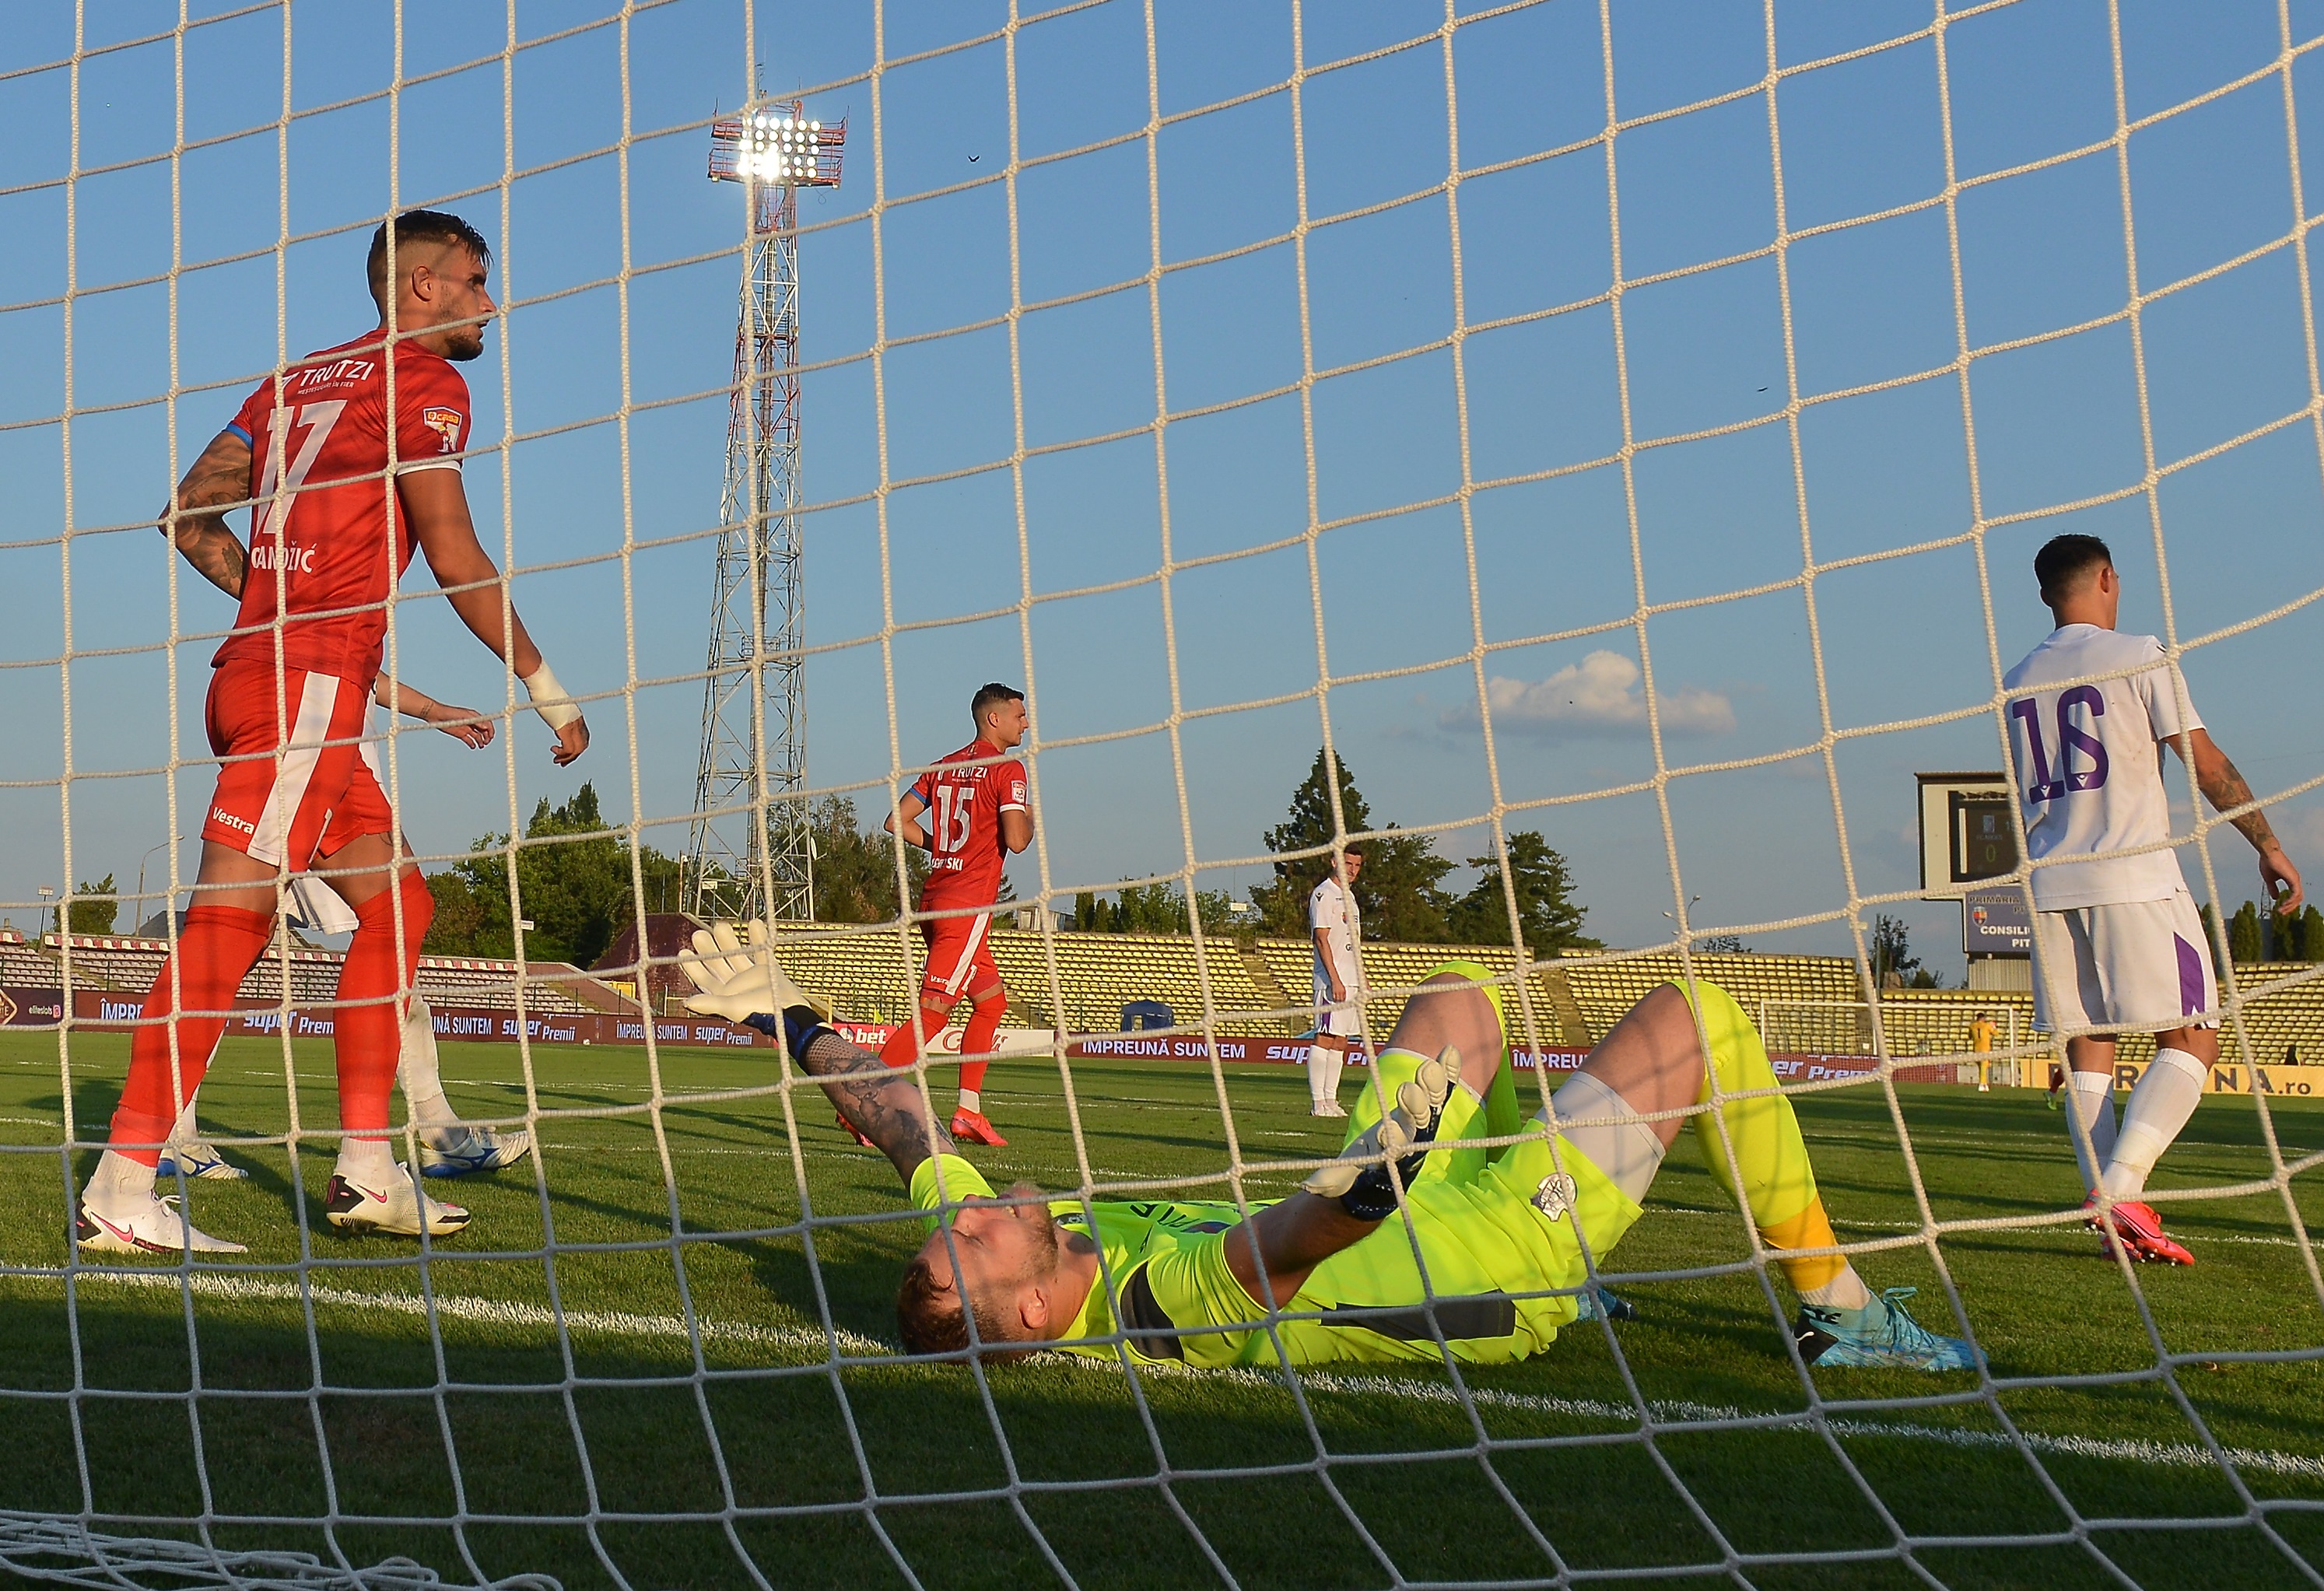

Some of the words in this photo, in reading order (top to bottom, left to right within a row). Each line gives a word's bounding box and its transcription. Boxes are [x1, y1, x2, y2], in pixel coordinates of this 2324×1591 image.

[300, 359, 375, 387] TRUTZI
[254, 399, 348, 540] 17
[2012, 685, 2109, 804] 16
[212, 807, 255, 835] Vestra
[937, 785, 975, 853] 15
[1980, 925, 2030, 935] CONSILI
[243, 1008, 297, 1034] supr
[452, 1016, 492, 1035] SUNTEM
[542, 1025, 576, 1042] Premii
[616, 1019, 656, 1040] ÎMPREU
[657, 1024, 688, 1041] SUNTEM
[694, 1025, 726, 1046] super
[727, 1031, 753, 1046] Premii
[855, 1028, 886, 1044] bet
[1173, 1042, 1246, 1058] SUNEM
[1512, 1048, 1588, 1069] ÎMPREU
[1768, 1060, 1803, 1074] er
